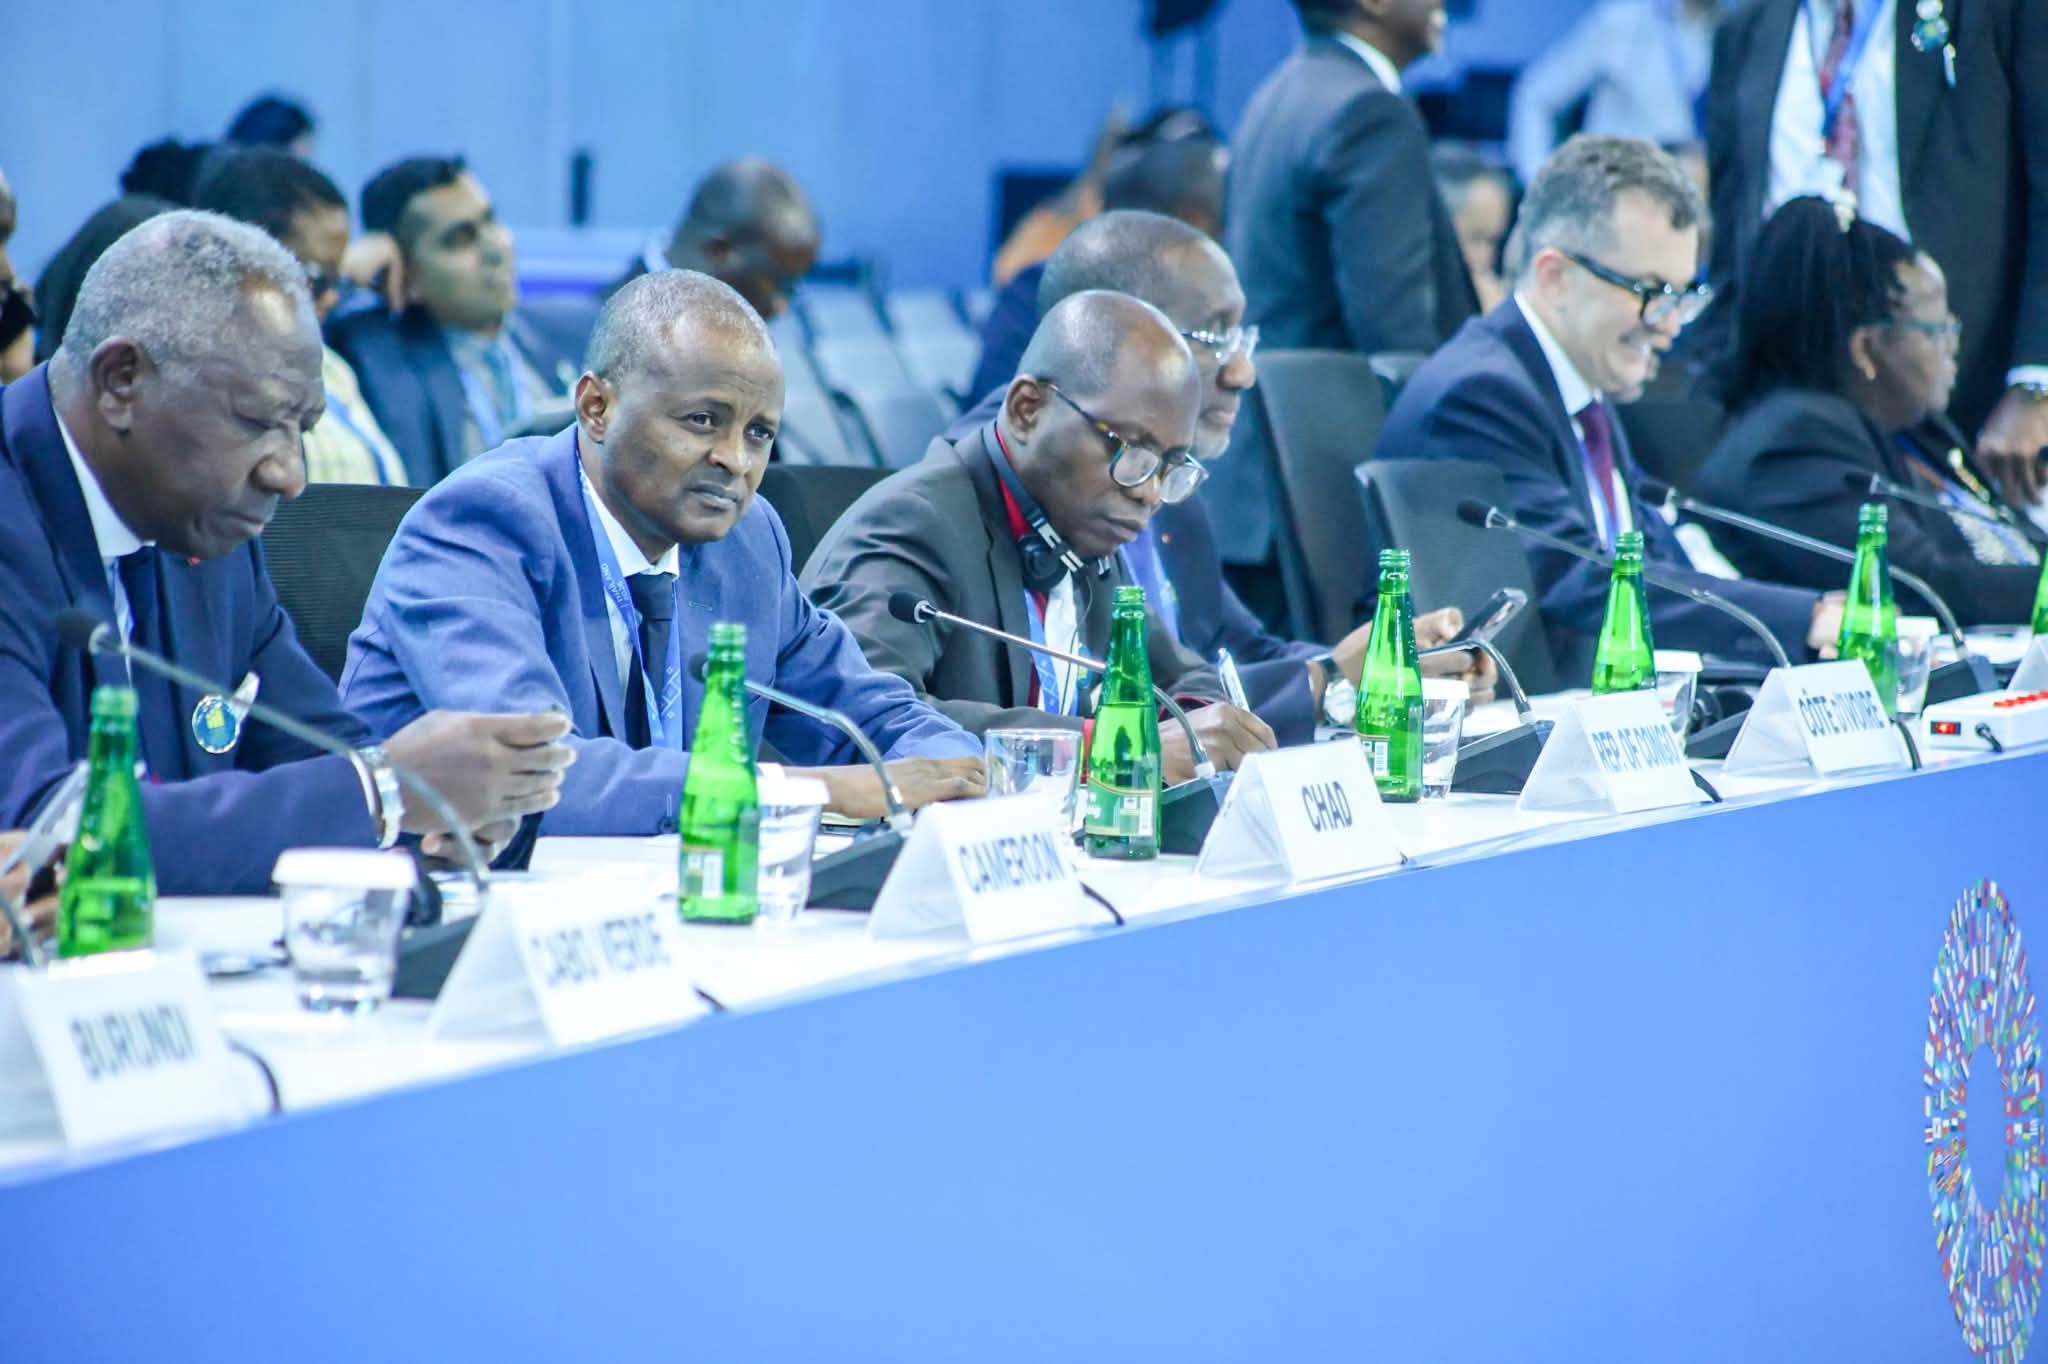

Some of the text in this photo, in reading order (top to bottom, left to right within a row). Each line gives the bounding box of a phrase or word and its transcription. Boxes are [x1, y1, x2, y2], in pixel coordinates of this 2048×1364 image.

[1798, 687, 1840, 736] CÔTE
[1617, 727, 1642, 770] OF
[1633, 724, 1681, 768] CONGO
[1301, 781, 1353, 832] CHAD
[958, 832, 1065, 893] CAMEROON
[601, 911, 671, 972] VERDE
[68, 1003, 194, 1081] BURUNDI
